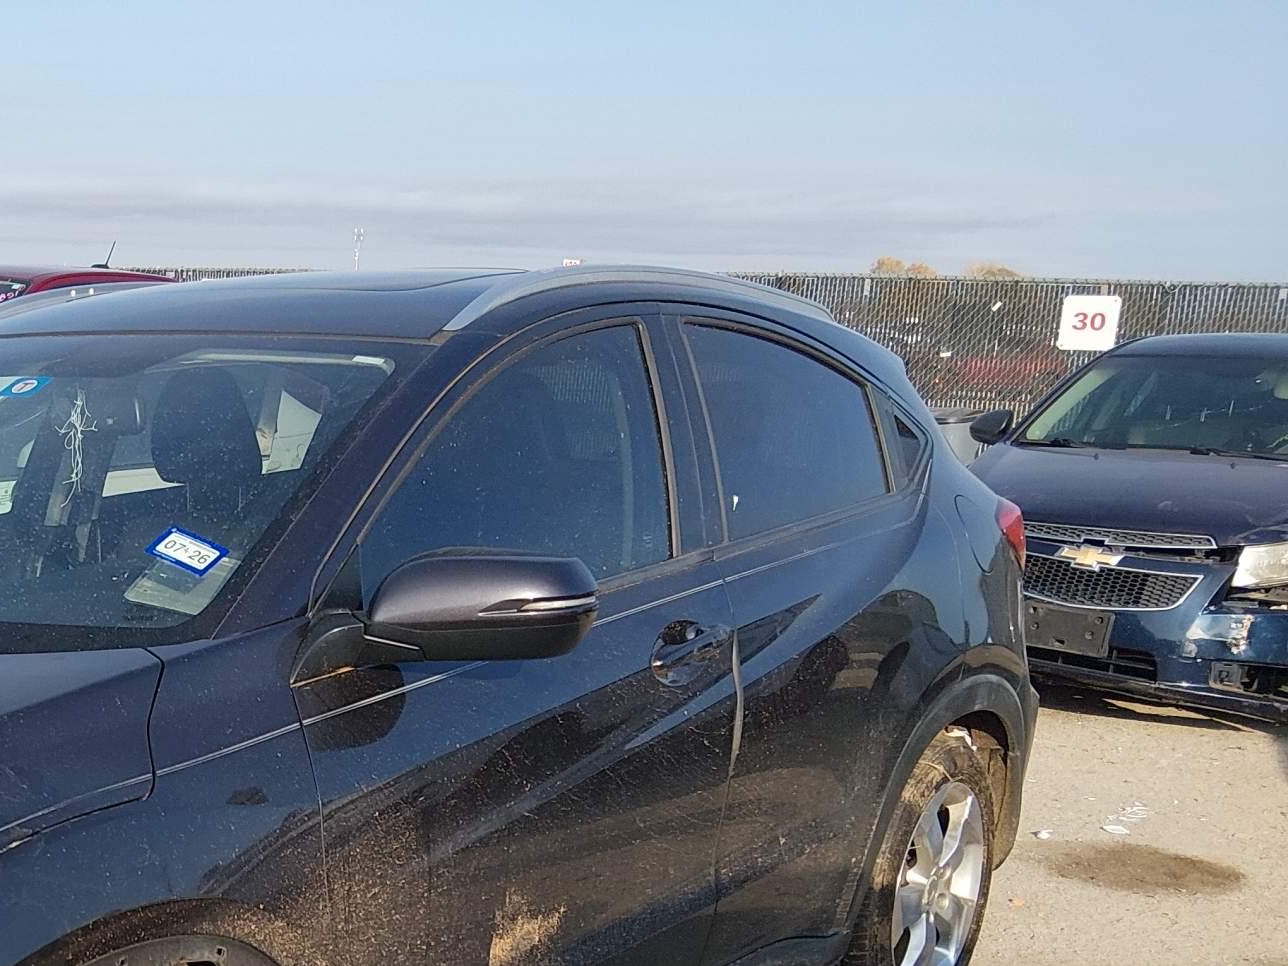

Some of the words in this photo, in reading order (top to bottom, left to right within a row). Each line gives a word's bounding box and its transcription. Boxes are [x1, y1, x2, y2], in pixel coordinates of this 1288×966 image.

[1071, 312, 1106, 331] 30
[164, 540, 186, 552] 07
[188, 550, 211, 564] 26
